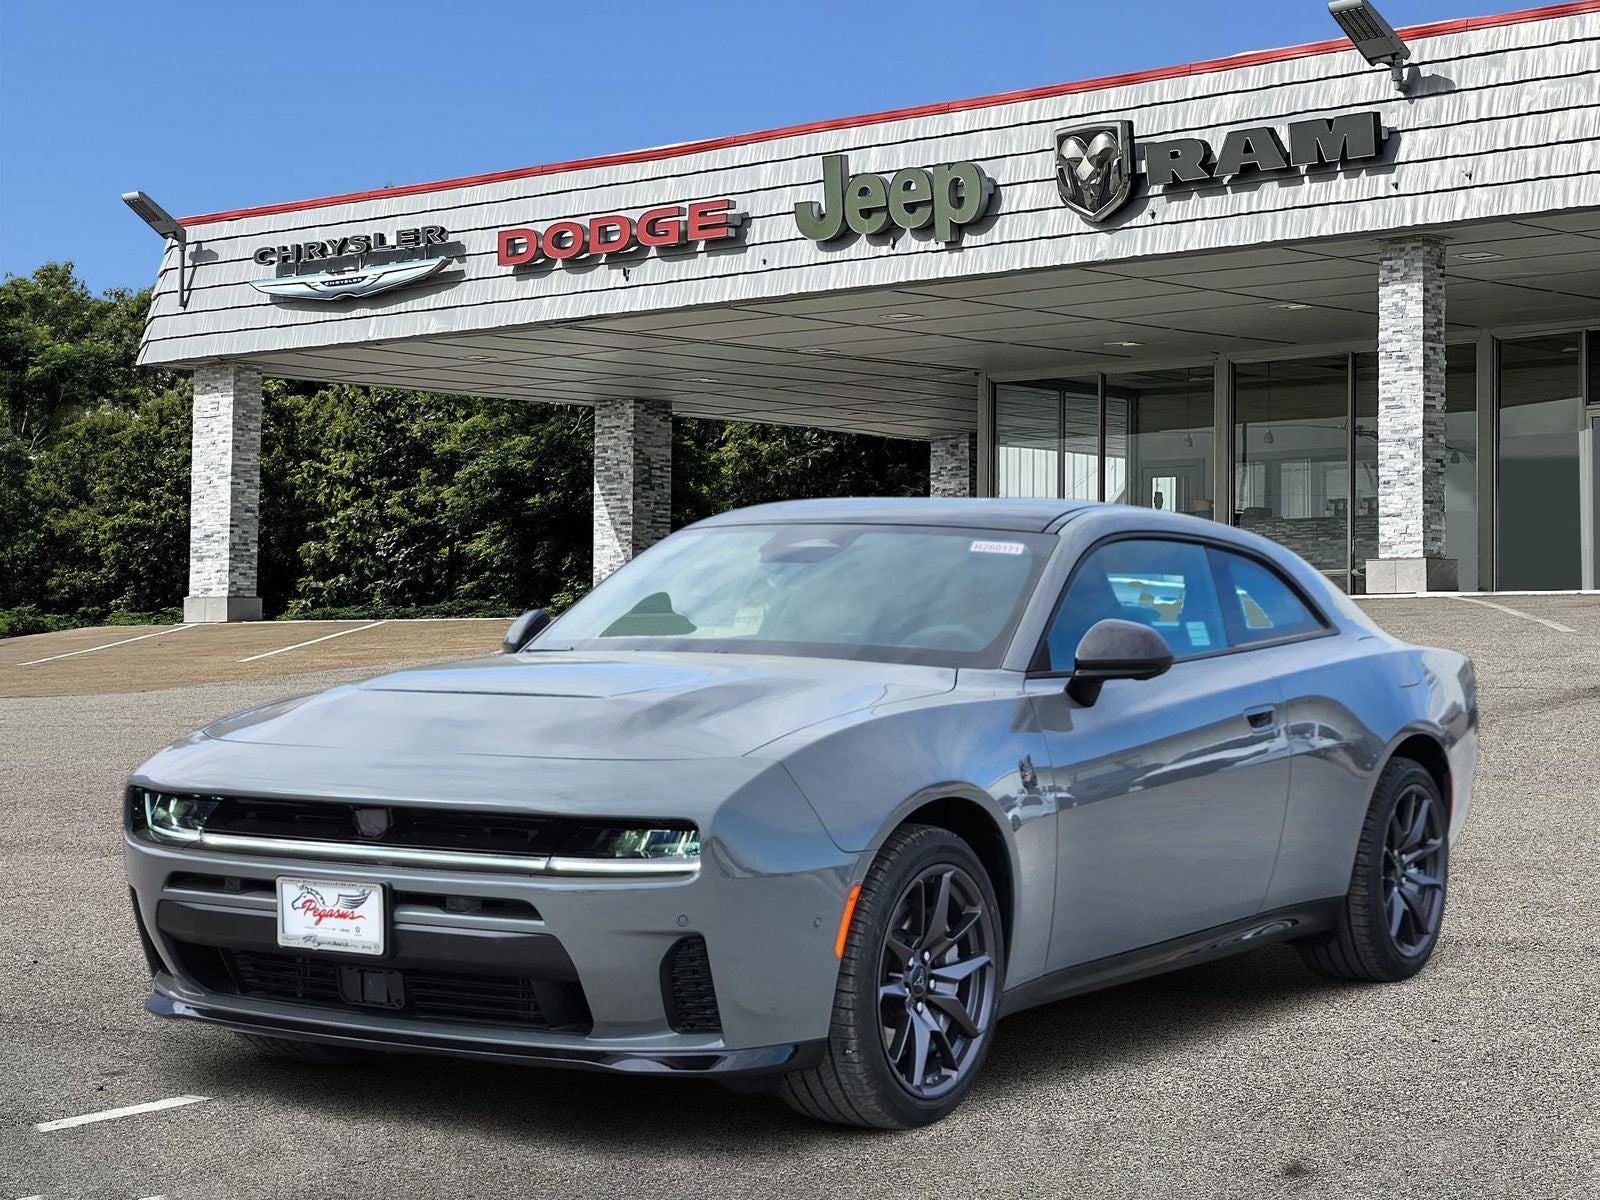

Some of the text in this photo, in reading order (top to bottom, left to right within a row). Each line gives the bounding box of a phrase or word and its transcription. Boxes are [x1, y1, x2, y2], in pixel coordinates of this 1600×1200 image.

[1145, 111, 1379, 186] RAM
[794, 154, 986, 242] Jeep
[253, 225, 448, 266] CHRYSLER
[497, 199, 735, 266] DODGE
[302, 899, 366, 926] Pegasus
